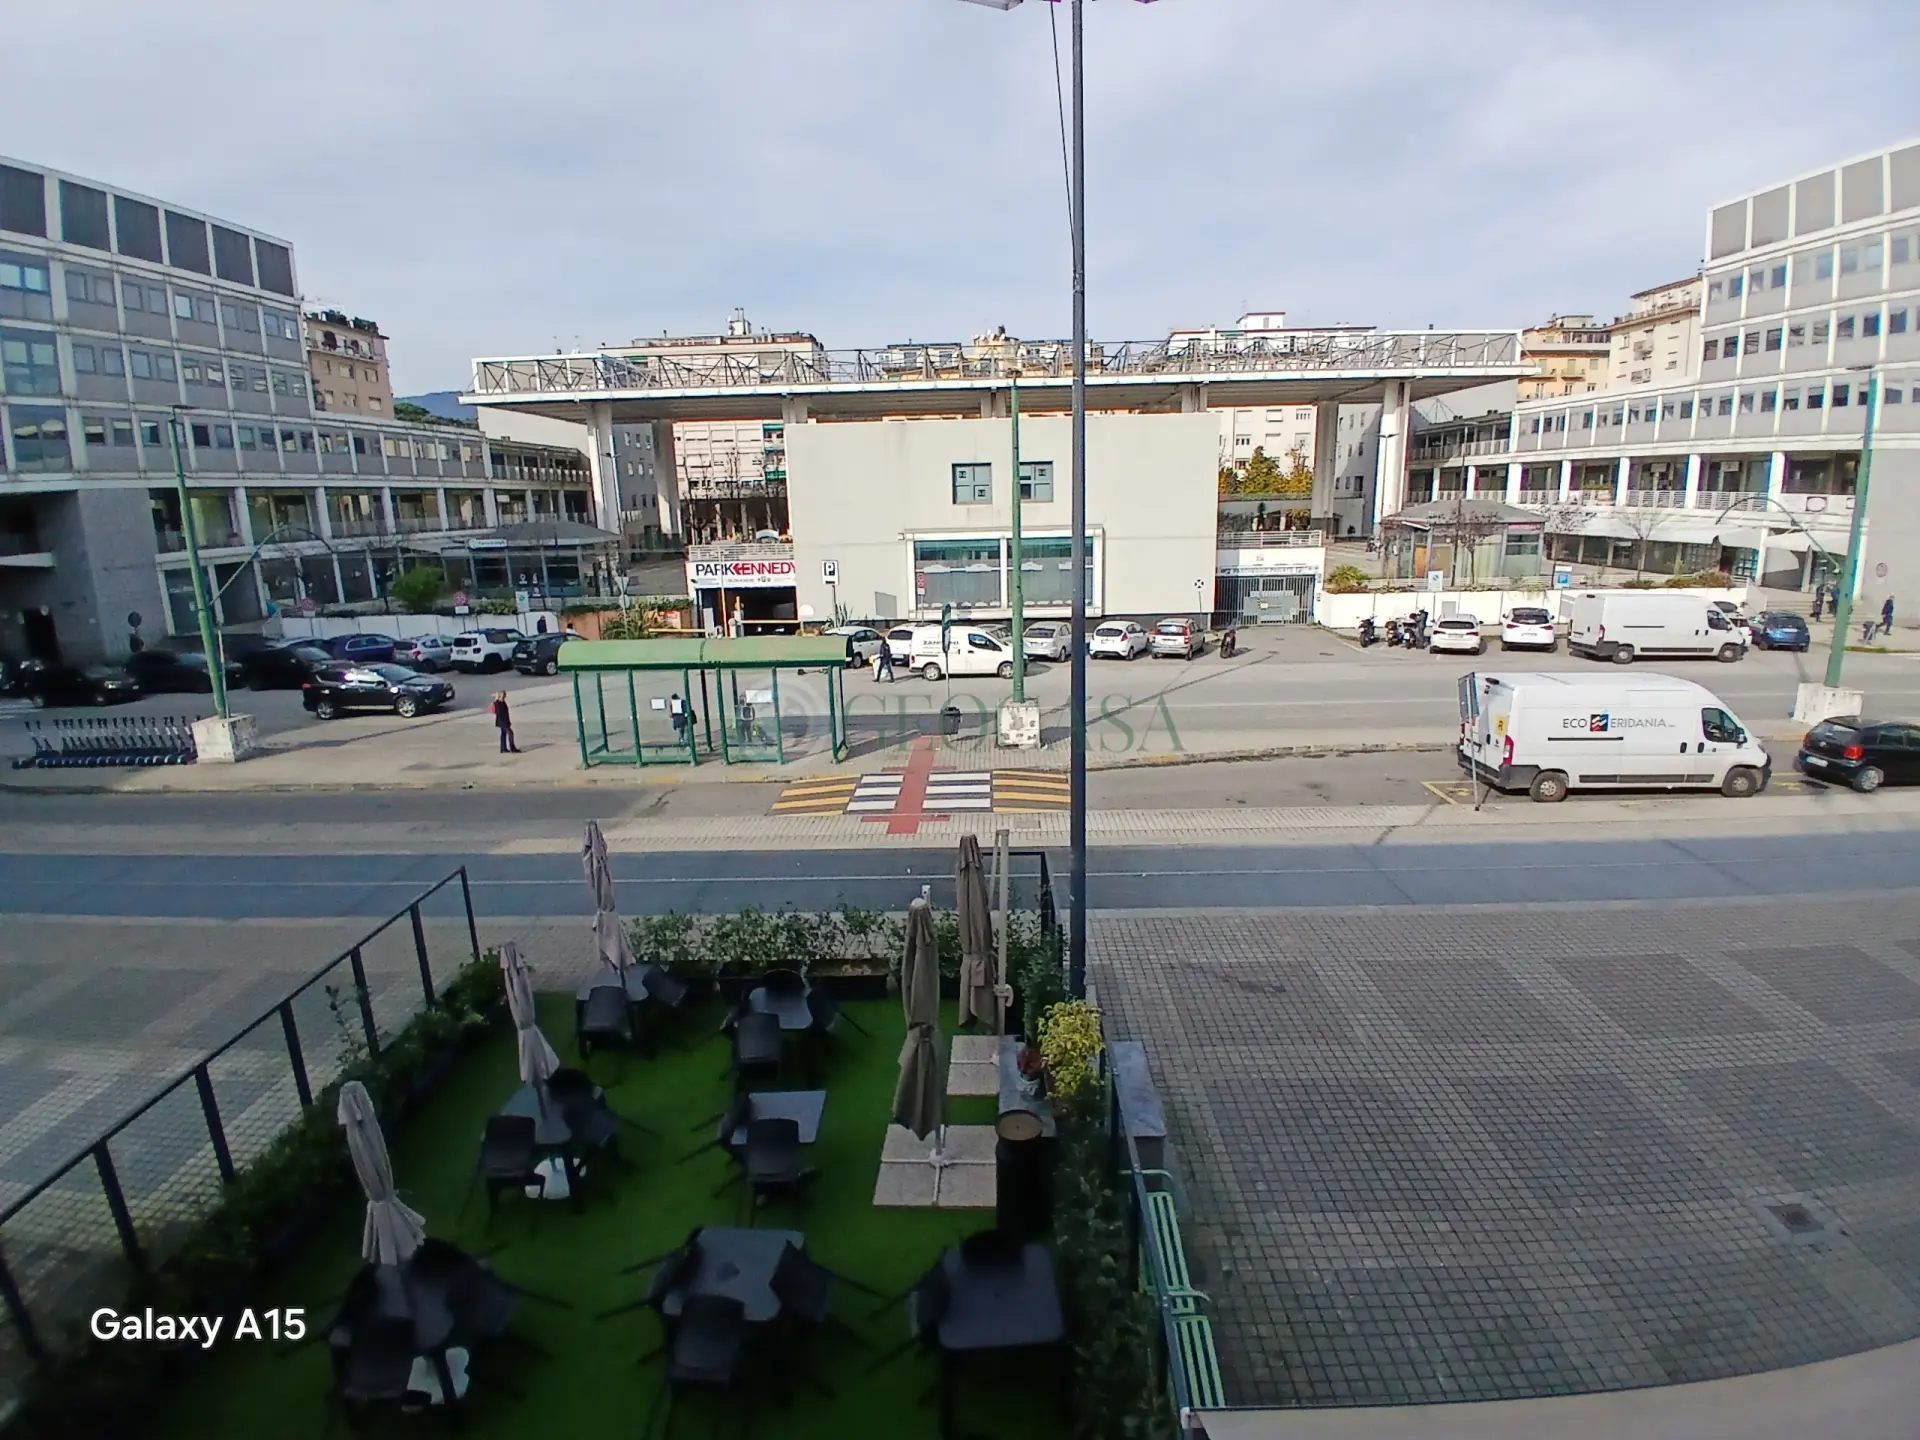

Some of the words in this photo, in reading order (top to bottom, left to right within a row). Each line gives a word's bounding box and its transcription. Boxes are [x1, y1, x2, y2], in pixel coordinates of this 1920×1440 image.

[695, 563, 733, 576] PARK
[1562, 718, 1588, 729] ECO
[1610, 717, 1667, 728] ERIDANIA
